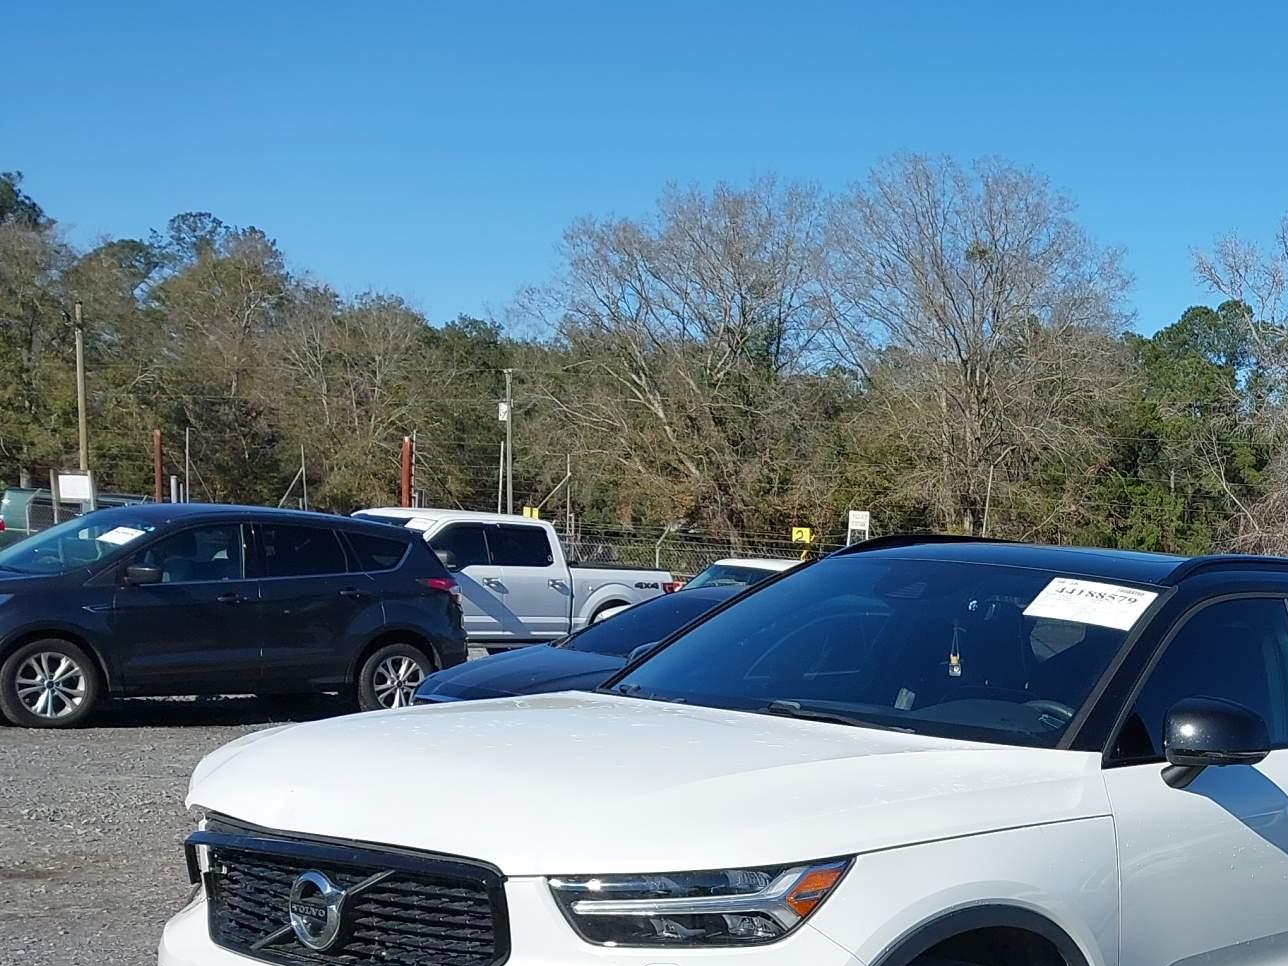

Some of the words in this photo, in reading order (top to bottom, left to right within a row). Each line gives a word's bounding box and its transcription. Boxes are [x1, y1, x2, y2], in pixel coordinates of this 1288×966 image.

[794, 529, 806, 543] 2
[1055, 587, 1138, 605] 44188579
[292, 903, 326, 917] VOLVO
